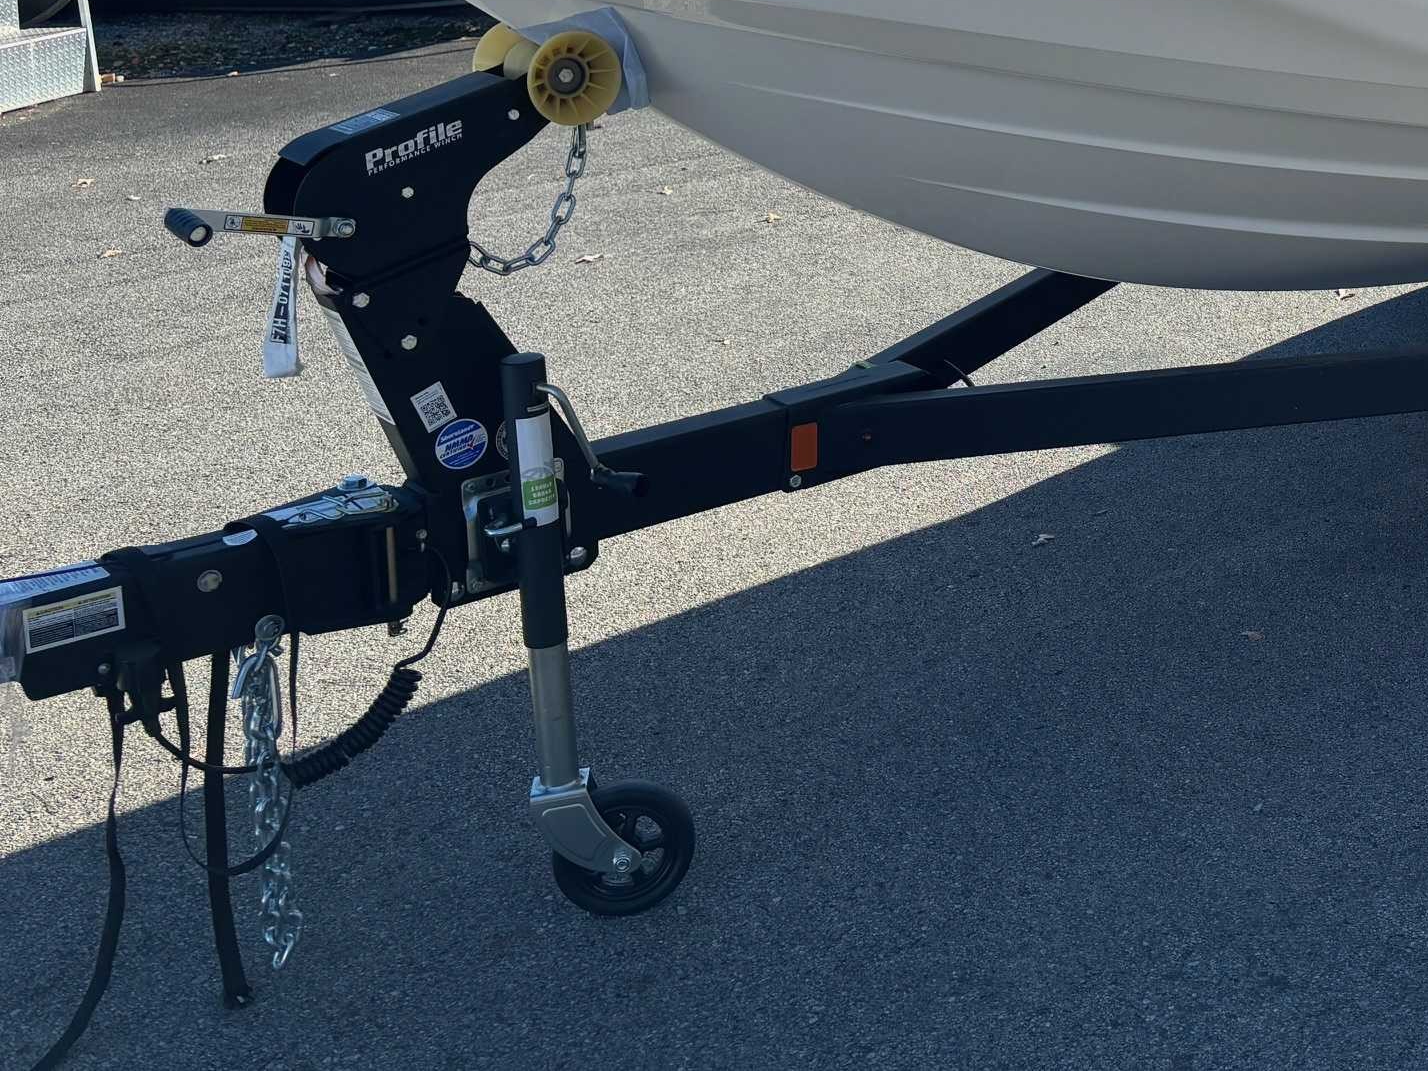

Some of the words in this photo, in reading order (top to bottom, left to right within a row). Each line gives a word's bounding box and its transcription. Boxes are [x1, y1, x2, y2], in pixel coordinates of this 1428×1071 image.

[365, 120, 462, 171] Profile
[368, 145, 431, 176] PERFORMANCE
[434, 133, 463, 148] WINCH
